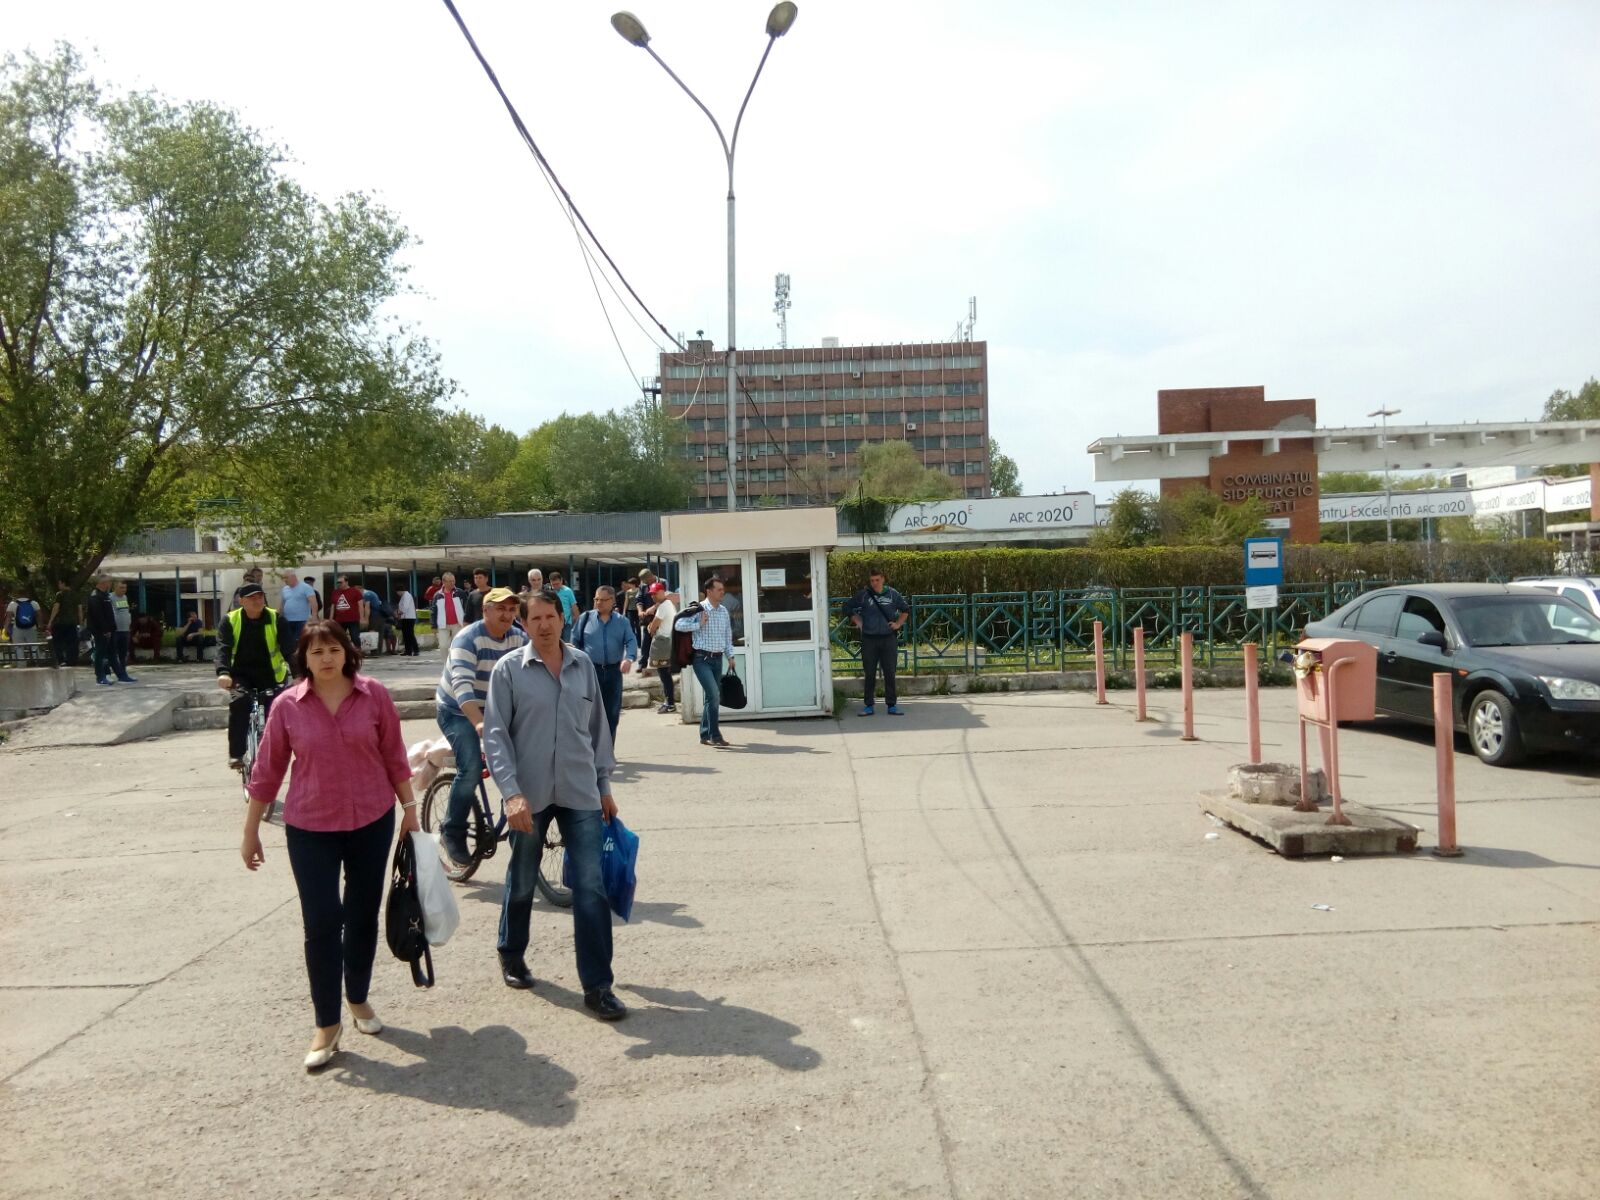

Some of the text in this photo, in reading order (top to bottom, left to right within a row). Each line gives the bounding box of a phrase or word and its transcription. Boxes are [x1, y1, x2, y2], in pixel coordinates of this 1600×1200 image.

[1318, 507, 1347, 519] entru
[1417, 504, 1435, 514] ARC
[905, 516, 928, 528] ARC
[1009, 512, 1034, 523] ARC
